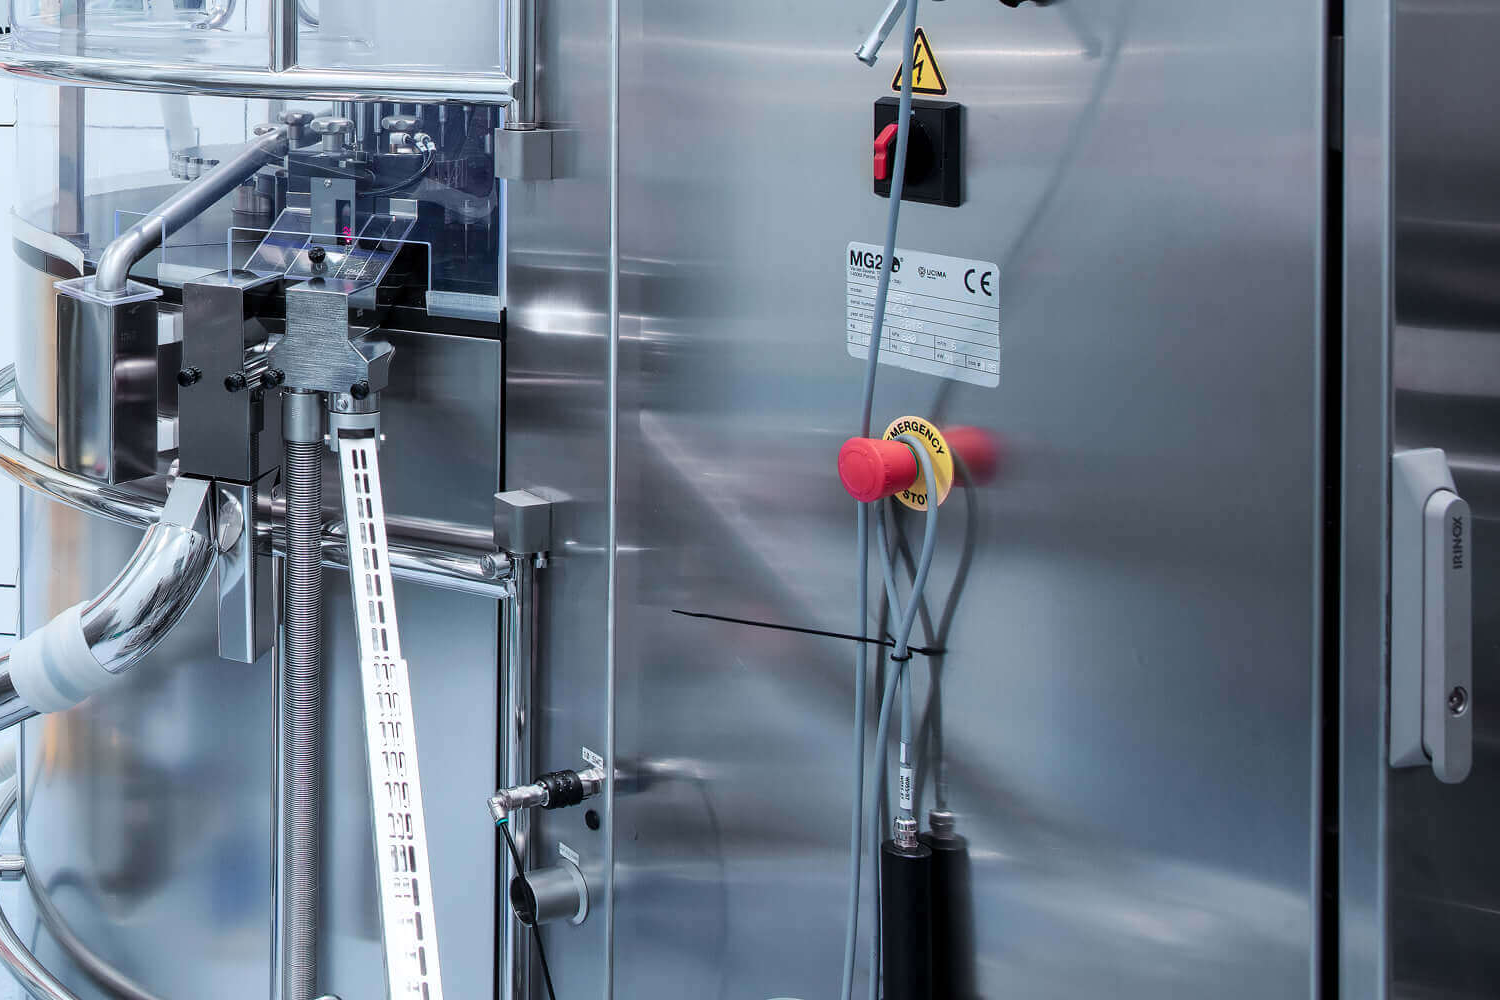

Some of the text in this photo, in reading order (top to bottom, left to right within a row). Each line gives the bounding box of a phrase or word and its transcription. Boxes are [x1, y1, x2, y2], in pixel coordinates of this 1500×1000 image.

[850, 249, 883, 270] MG2
[902, 489, 928, 505] STO
[1452, 516, 1463, 569] IRINOX
